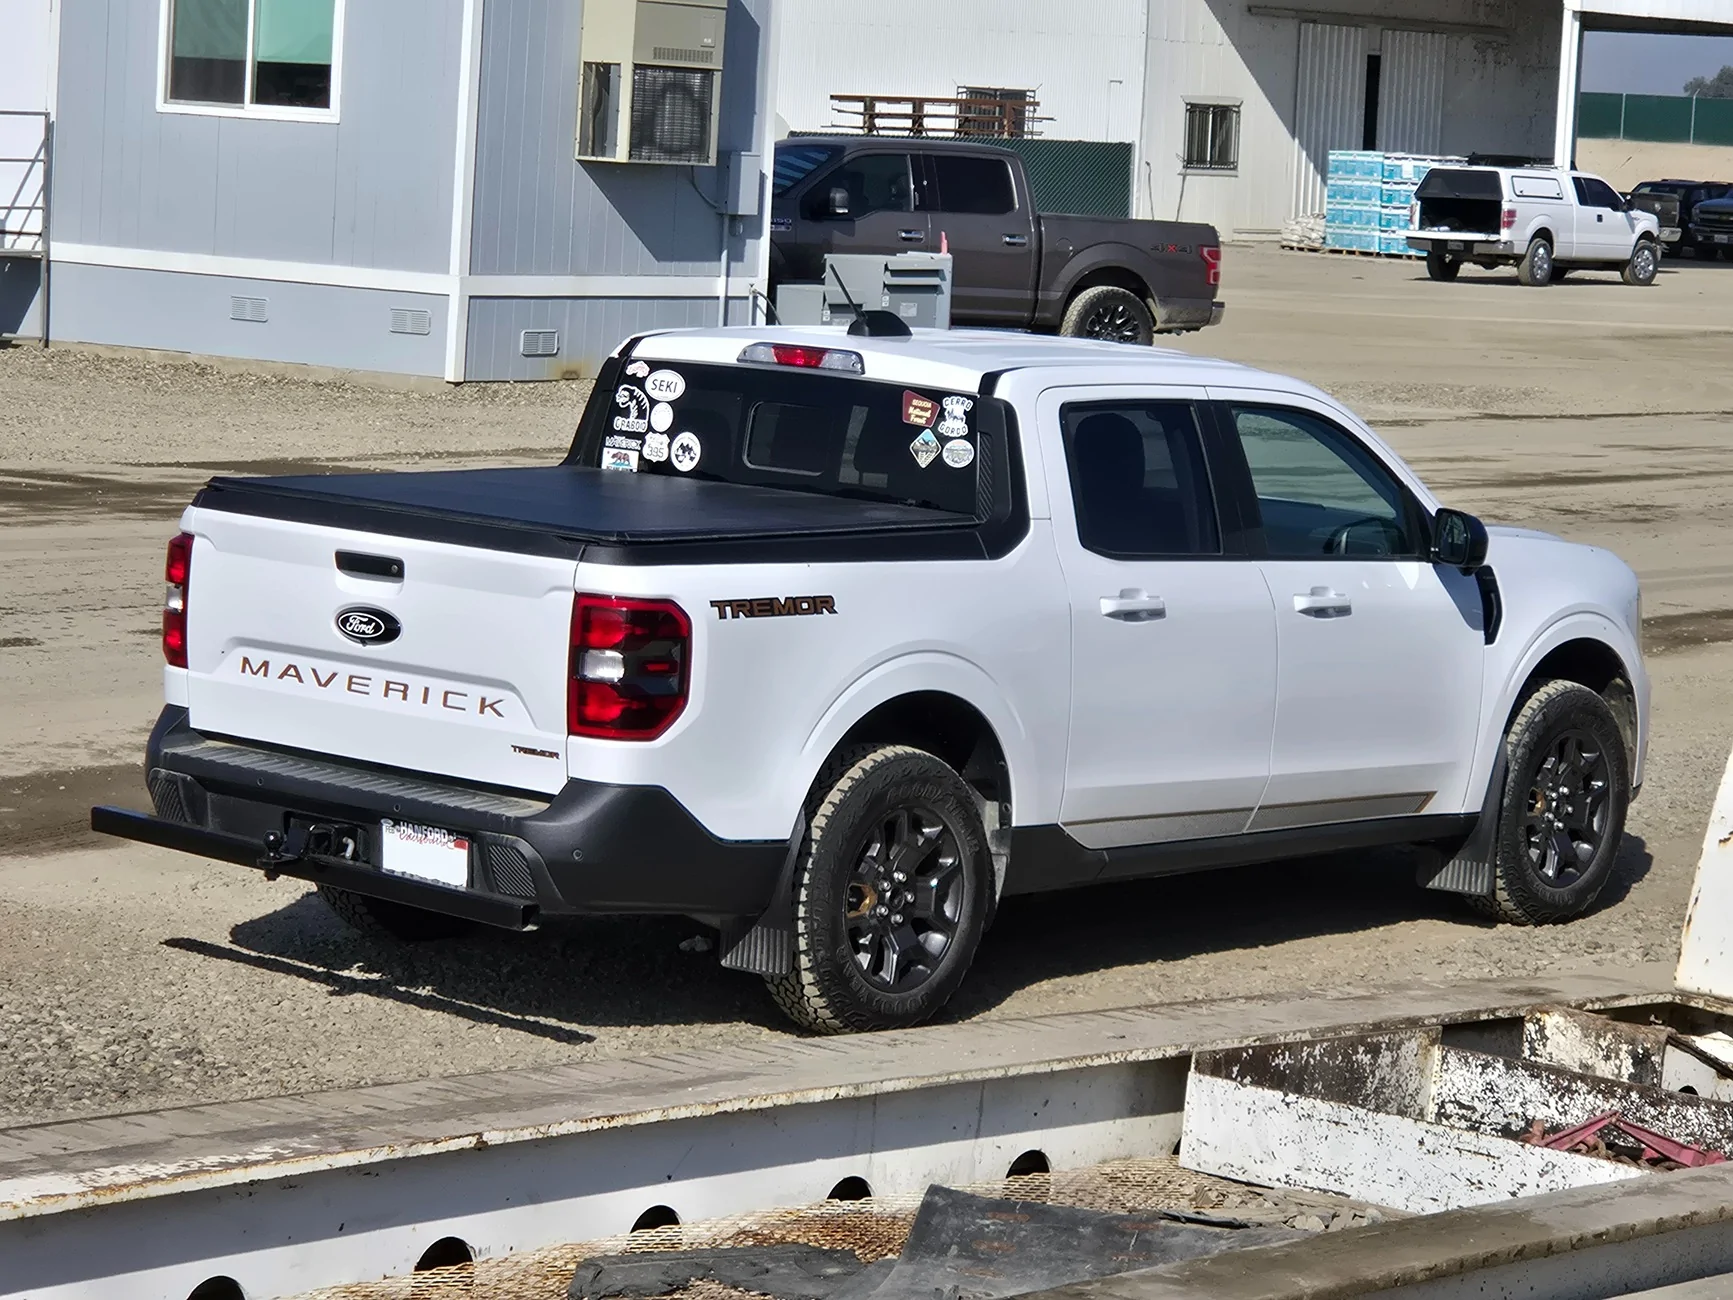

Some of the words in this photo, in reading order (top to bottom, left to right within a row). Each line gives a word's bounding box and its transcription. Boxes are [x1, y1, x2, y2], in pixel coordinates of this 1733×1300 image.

[650, 378, 678, 394] SEKI
[944, 397, 972, 410] CERRO
[939, 423, 967, 436] GORDO
[646, 445, 665, 459] 395
[709, 595, 839, 620] TREMOR
[345, 614, 376, 636] Ford
[239, 655, 505, 719] MAVERICK
[510, 743, 561, 760] TREMOR
[399, 821, 449, 843] HANFORD
